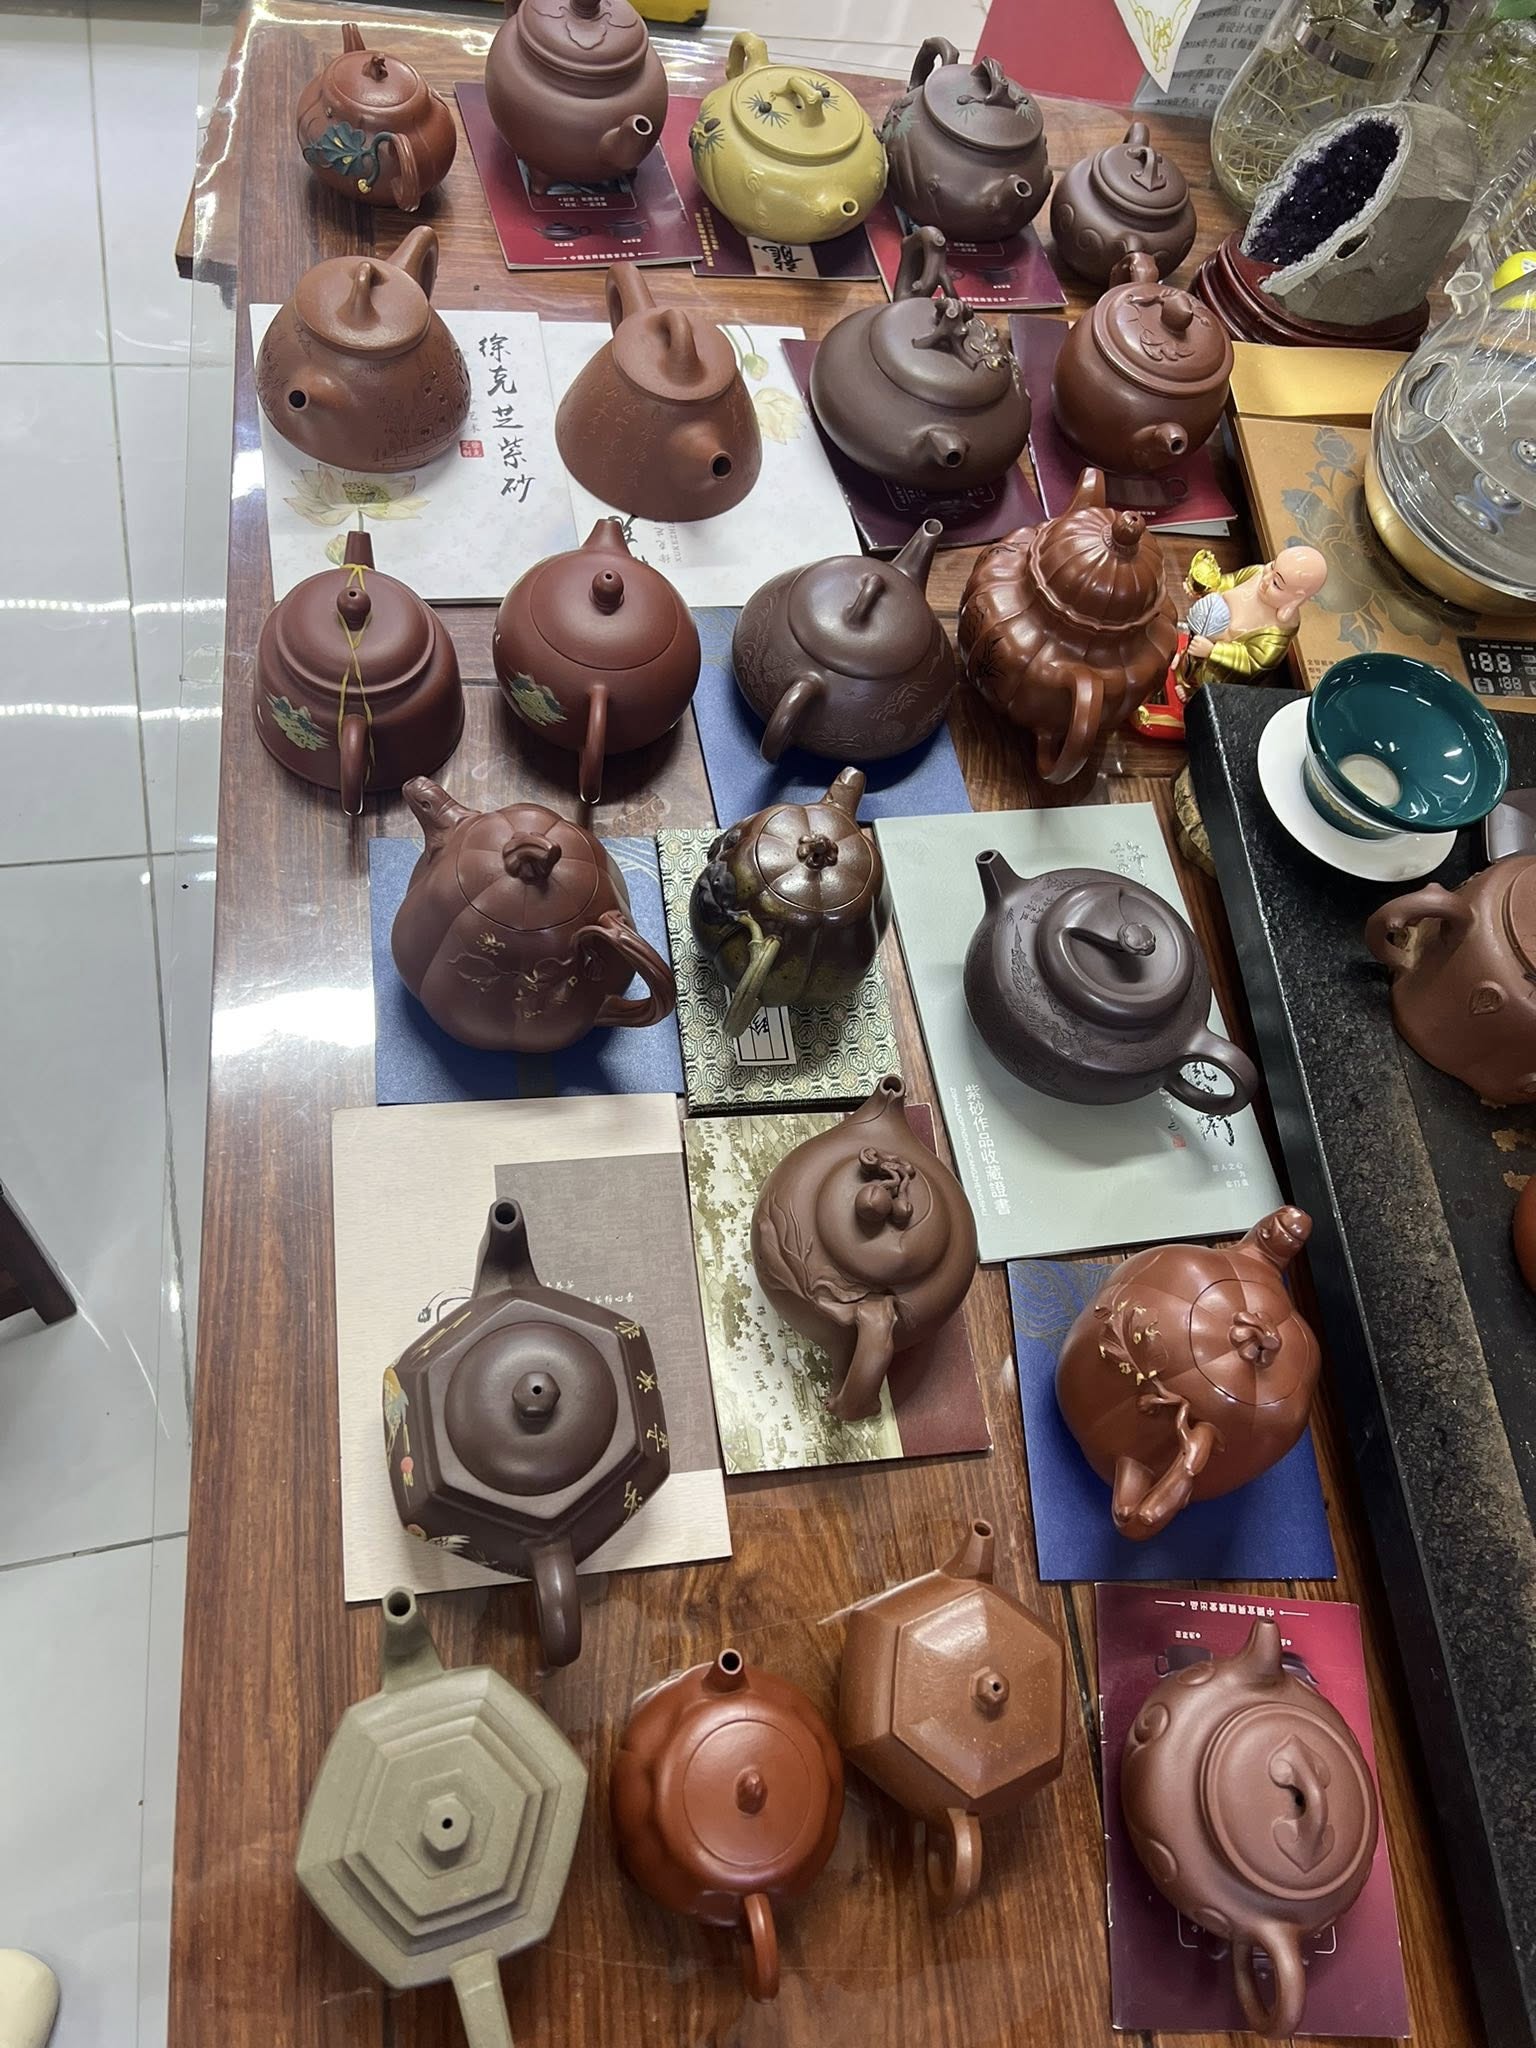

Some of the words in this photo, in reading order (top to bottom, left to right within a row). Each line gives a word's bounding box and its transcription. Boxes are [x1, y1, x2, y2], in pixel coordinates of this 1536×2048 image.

[478, 332, 536, 503] 徐克芝紫砂
[964, 1084, 1011, 1216] 紫砂作品收藏證書
